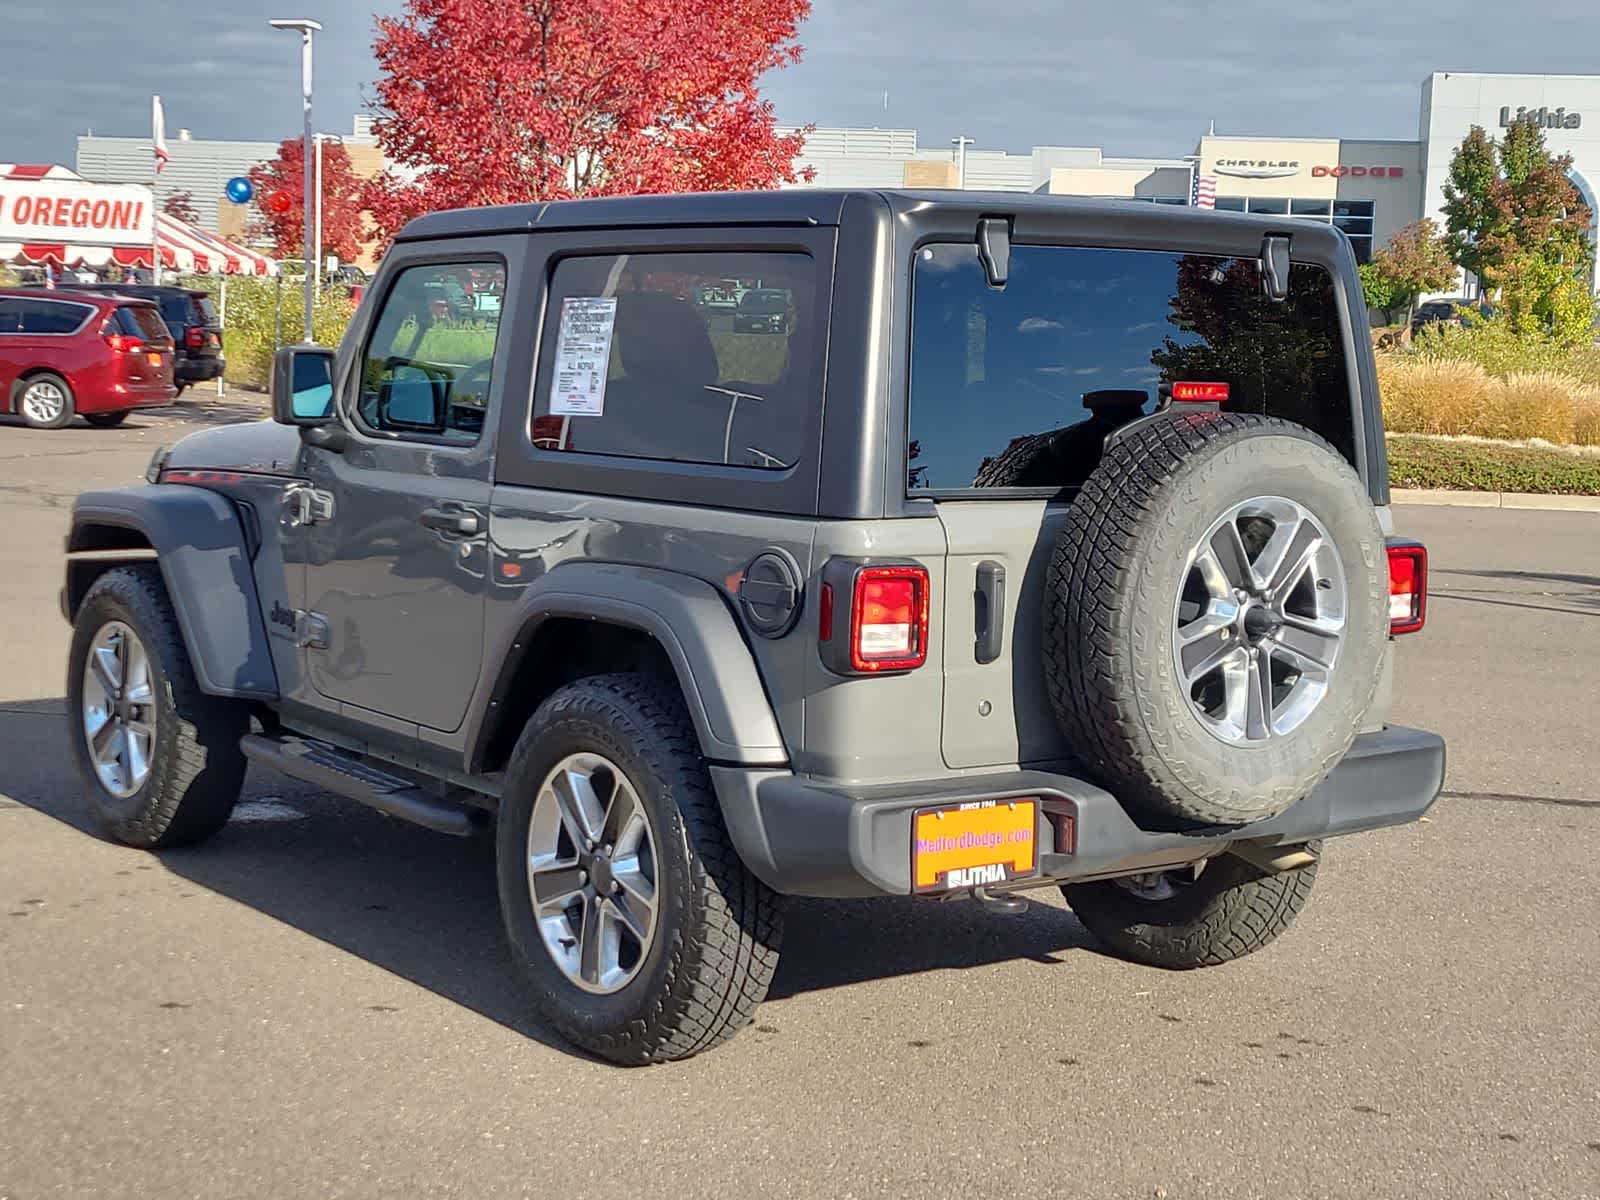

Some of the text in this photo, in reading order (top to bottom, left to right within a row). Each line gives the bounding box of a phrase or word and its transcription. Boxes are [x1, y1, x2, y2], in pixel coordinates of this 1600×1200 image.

[1216, 159, 1299, 168] CHRYSLER
[1311, 165, 1404, 178] DODGE
[12, 195, 144, 230] OREGON!
[917, 829, 1032, 854] MedfordDodge.com
[962, 863, 1007, 887] LITHIA
